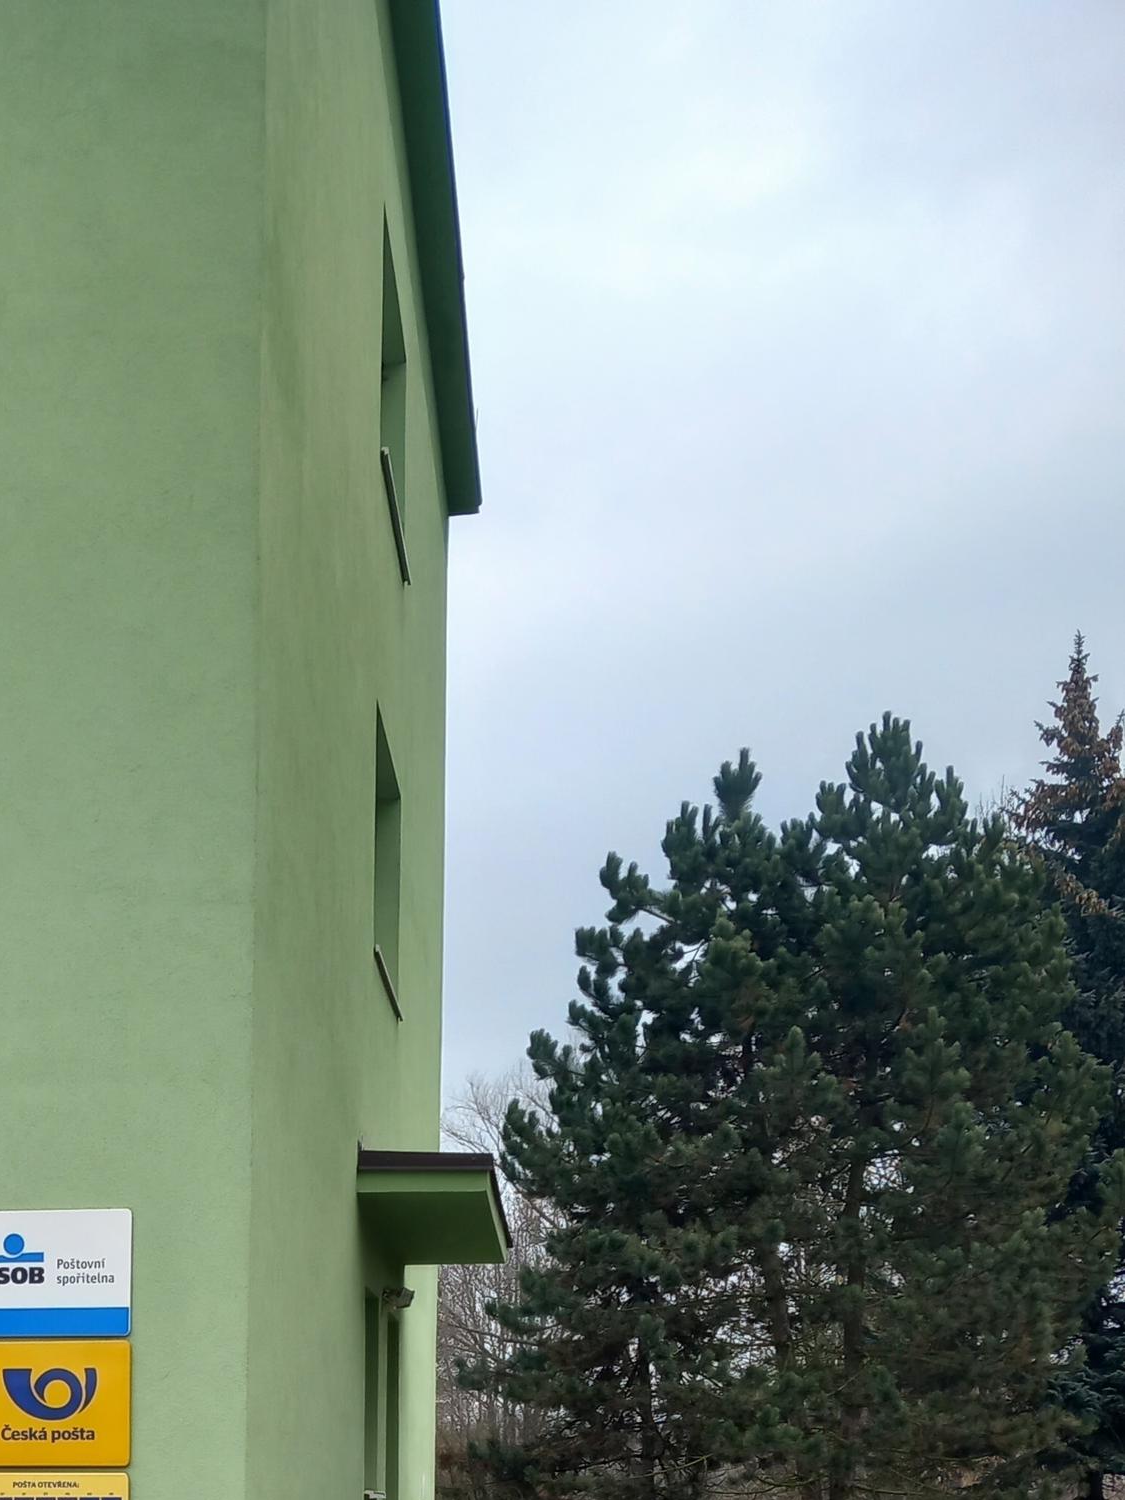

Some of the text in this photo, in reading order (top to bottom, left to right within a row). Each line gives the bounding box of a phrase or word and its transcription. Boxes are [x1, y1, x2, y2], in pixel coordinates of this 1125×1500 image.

[56, 1258, 105, 1270] Poštovní
[1, 1424, 95, 1443] Česká pošta
[12, 1480, 36, 1488] POŠTA
